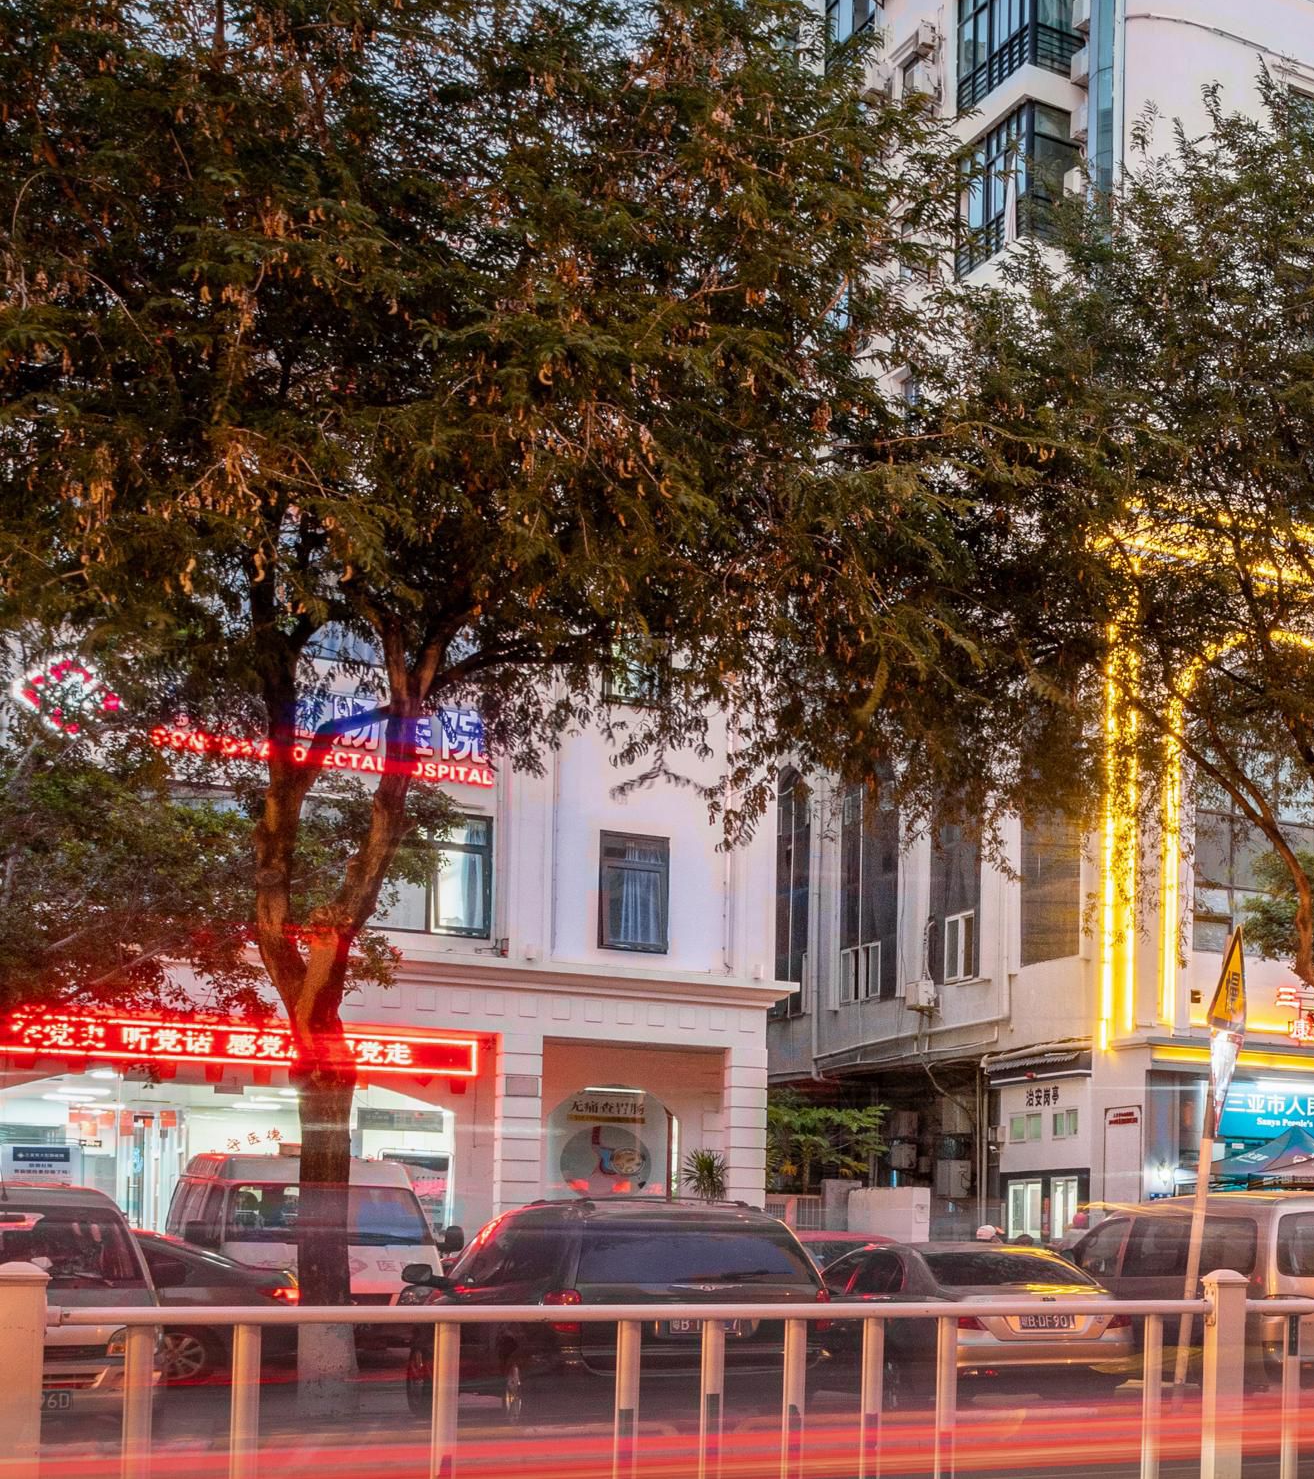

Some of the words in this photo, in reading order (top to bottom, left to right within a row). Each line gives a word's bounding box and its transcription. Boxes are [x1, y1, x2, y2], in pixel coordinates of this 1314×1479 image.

[122, 1027, 213, 1054] 听党话
[1026, 1086, 1059, 1106] 治安岗亭
